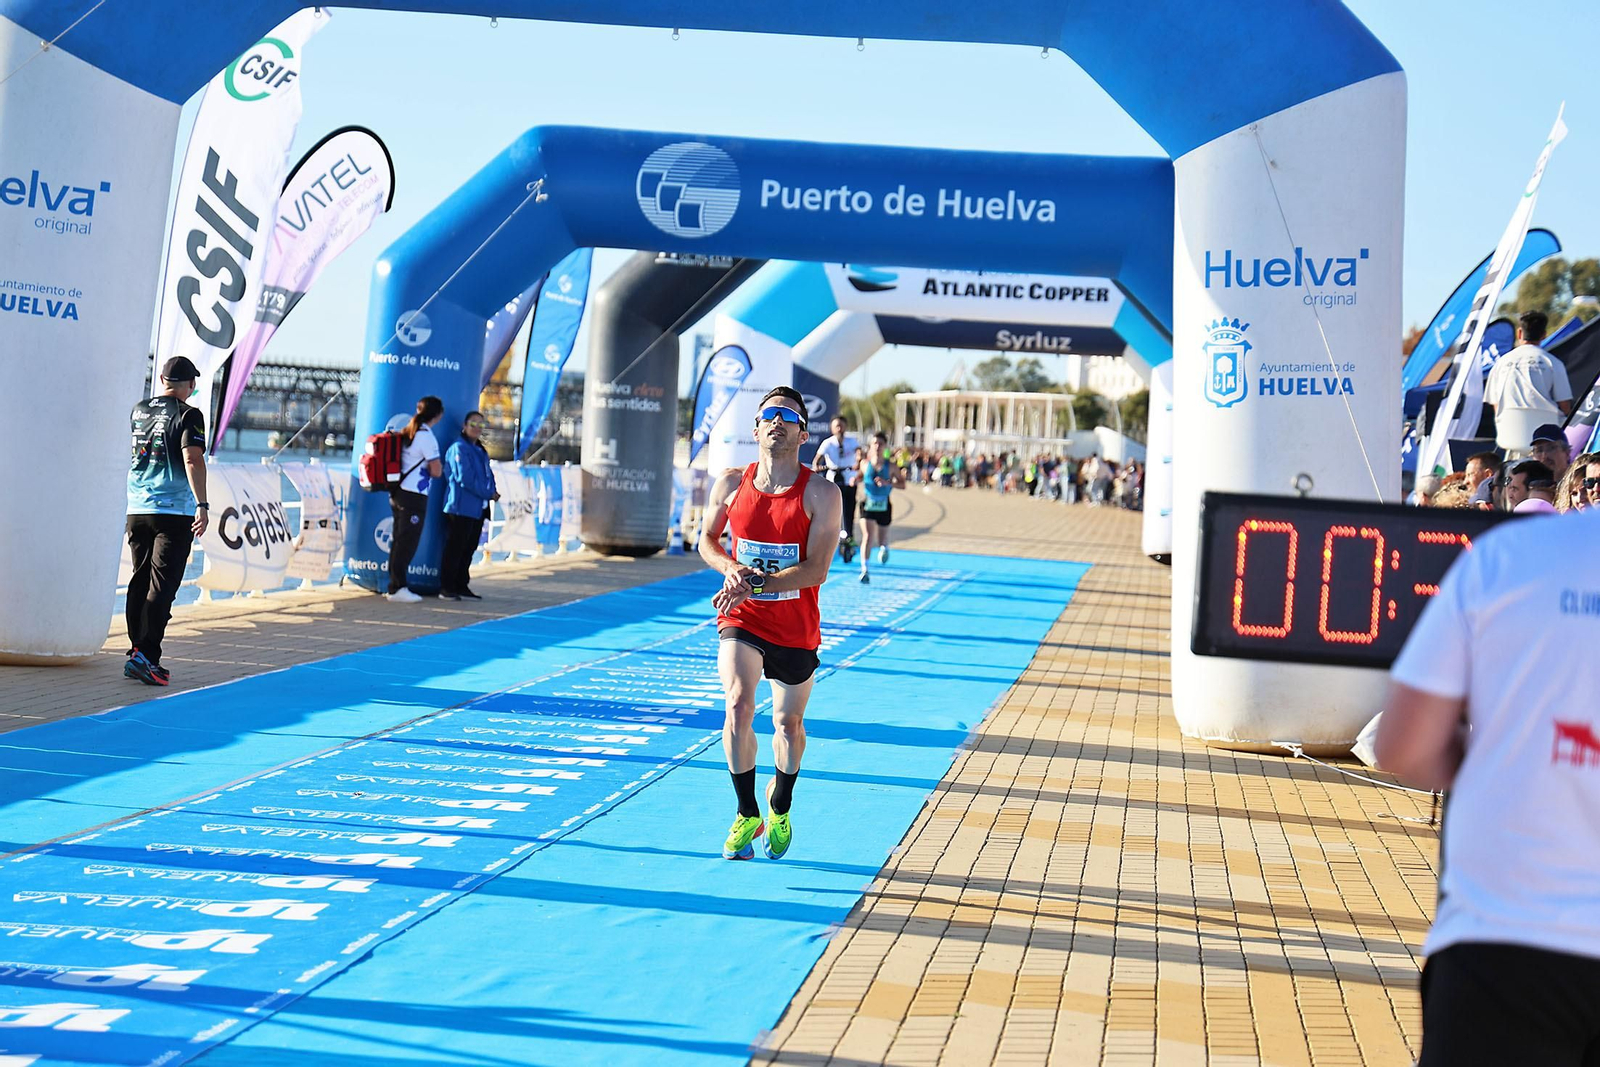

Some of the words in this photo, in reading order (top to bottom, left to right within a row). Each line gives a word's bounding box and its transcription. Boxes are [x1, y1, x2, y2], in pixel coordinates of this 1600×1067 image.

[241, 54, 297, 88] CSIF
[760, 179, 873, 213] Puerto
[883, 184, 926, 216] de
[937, 188, 1056, 222] Huelva
[34, 216, 92, 235] original
[177, 146, 260, 349] CSIF
[1204, 247, 1358, 288] Huelva
[68, 287, 83, 299] de
[922, 278, 1025, 300] ATLANTIC
[1028, 282, 1110, 303] COPPER
[1302, 291, 1357, 309] original
[996, 329, 1072, 352] Syrluz
[369, 351, 399, 364] Puerto
[401, 353, 416, 366] de
[419, 355, 460, 370] Huelva
[1259, 362, 1340, 375] Ayuntamiento
[1342, 361, 1356, 372] de
[1258, 377, 1355, 396] HUELVA
[606, 480, 650, 492] HUELVA
[407, 564, 439, 577] uelva
